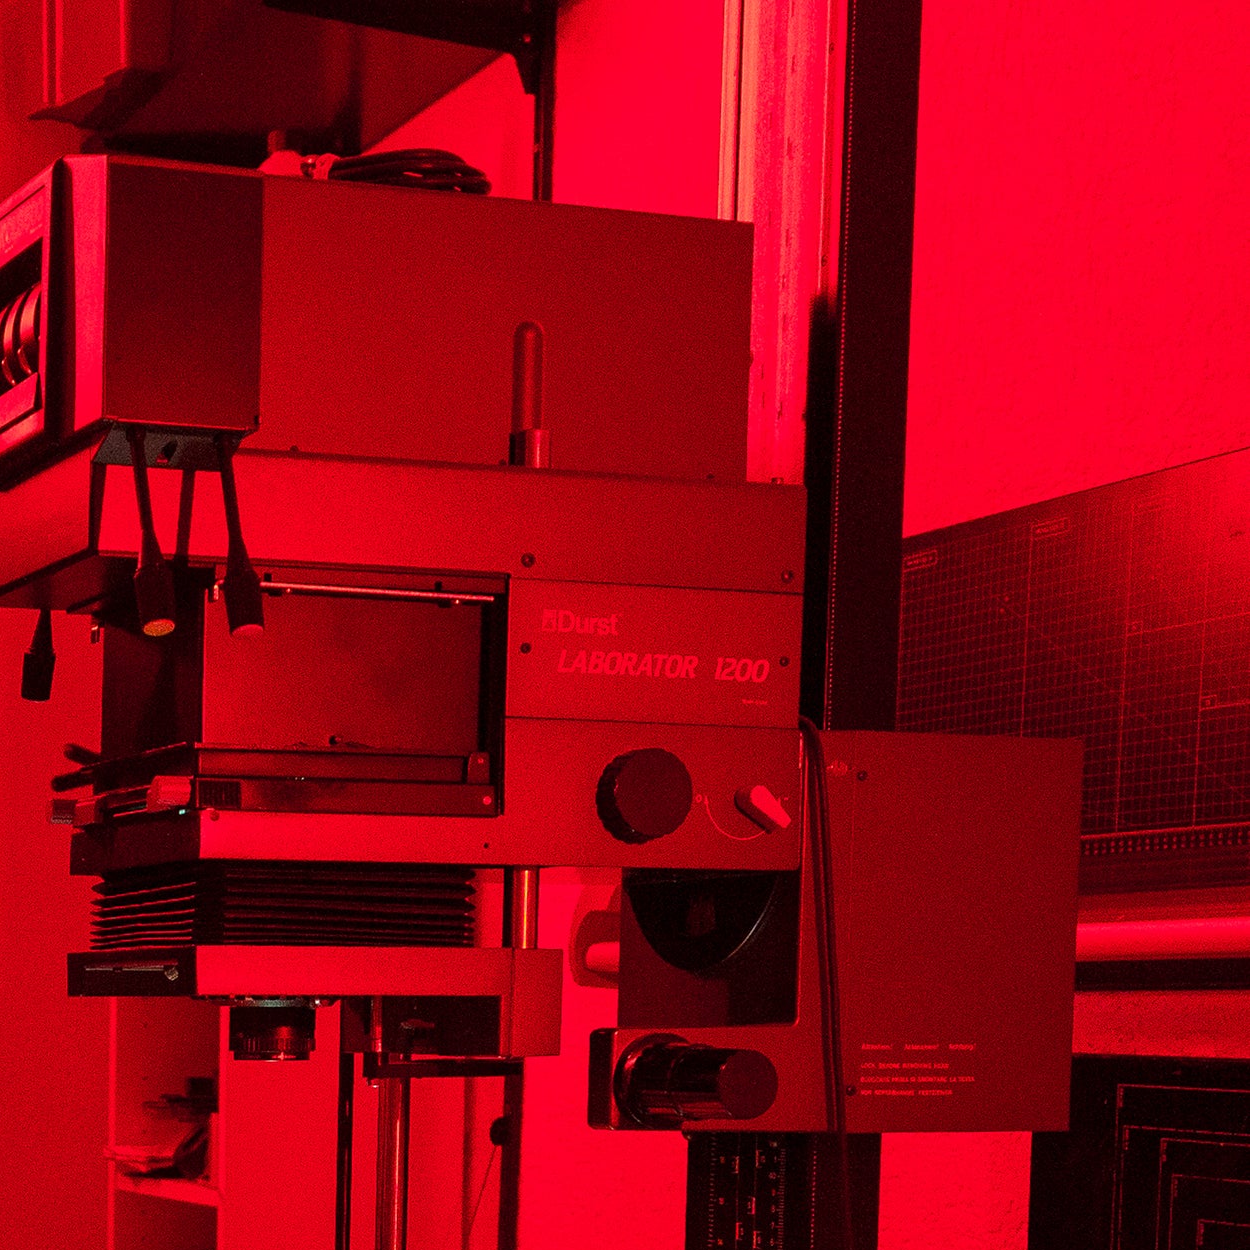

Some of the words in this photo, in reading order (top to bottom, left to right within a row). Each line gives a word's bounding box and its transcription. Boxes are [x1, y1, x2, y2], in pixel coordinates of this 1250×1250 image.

[557, 610, 619, 635] Durst
[557, 650, 699, 679] LABORATOR
[714, 656, 770, 683] 1200
